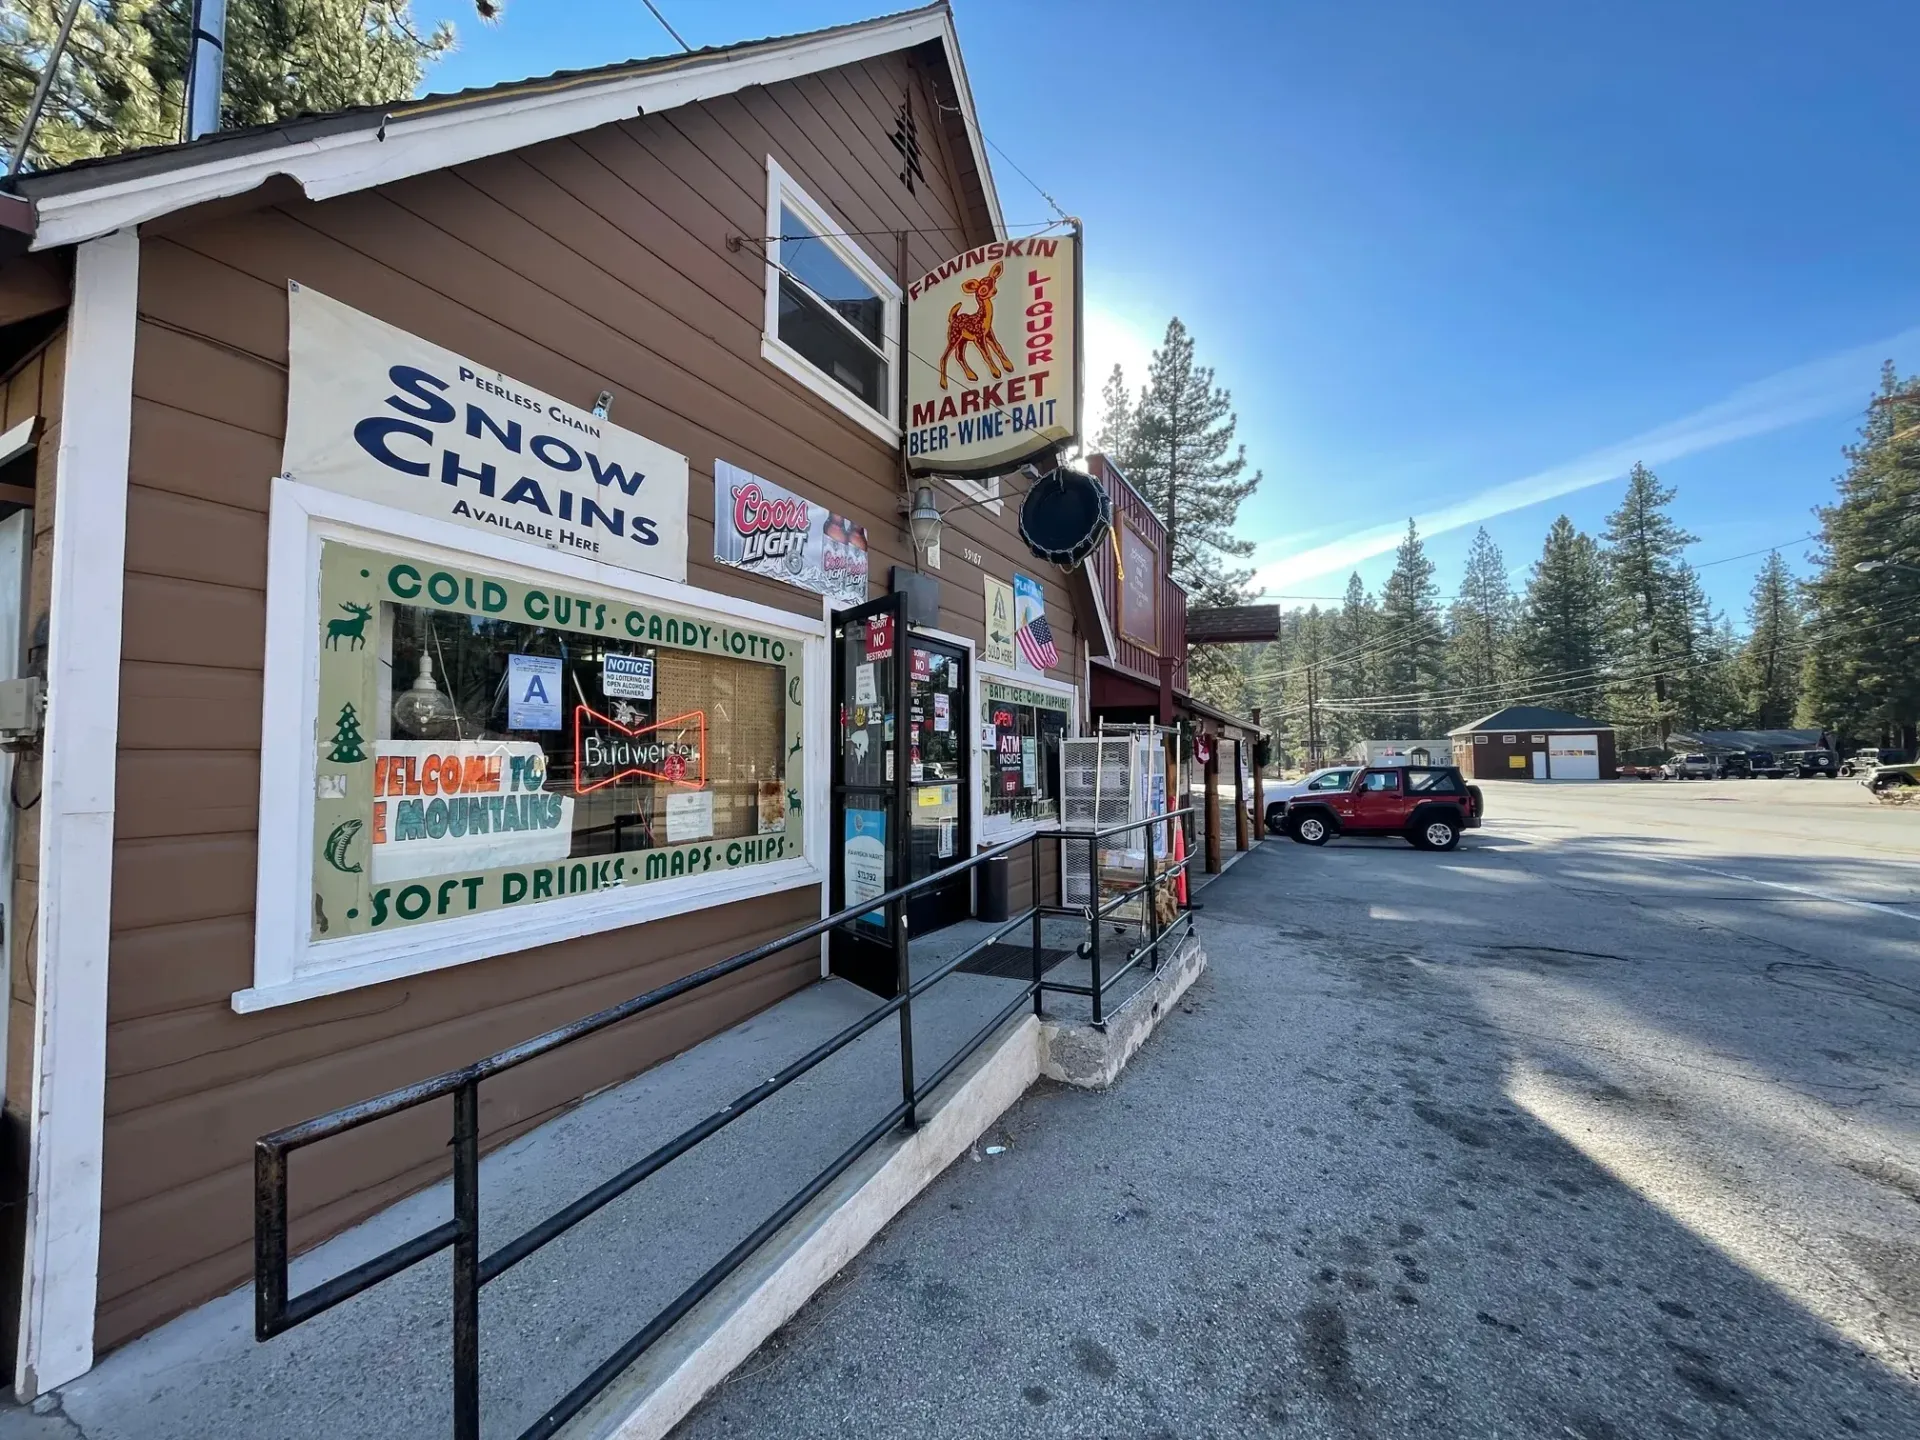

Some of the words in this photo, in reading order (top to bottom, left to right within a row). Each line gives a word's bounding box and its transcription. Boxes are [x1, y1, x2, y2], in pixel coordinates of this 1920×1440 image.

[909, 239, 1059, 301] FAWNSKIN
[1025, 270, 1054, 366] LIQUOR
[458, 366, 542, 414] PEERLESS
[549, 406, 600, 438] CHAIN
[912, 370, 1050, 428] MARKET
[384, 365, 645, 496] SNOW
[353, 416, 660, 546] CHAINS
[732, 483, 810, 535] Coors
[452, 500, 552, 541] AVAILABLE
[559, 529, 600, 553] HERE
[742, 531, 808, 563] LIGHT
[387, 564, 508, 613] COLD
[524, 590, 607, 631] CUTS
[625, 610, 712, 649] CANDY
[722, 629, 785, 662] LOTTO
[870, 619, 888, 631] SORRY
[866, 648, 893, 661] RESTROOM
[873, 632, 885, 648] NO
[606, 673, 615, 681] NO
[615, 675, 642, 683] LOITERING
[607, 658, 651, 675] NOTICE
[915, 659, 925, 671] NO
[523, 674, 549, 704] A
[606, 680, 621, 688] OPEN
[612, 688, 645, 697] CONTAINERS
[989, 684, 1006, 700] BAIT
[1011, 688, 1022, 702] ICE
[993, 711, 1014, 728] OPEN
[999, 753, 1021, 765] INSIDE
[1000, 735, 1020, 753] ATM
[510, 755, 546, 792] TO
[1006, 781, 1016, 791] EBT
[395, 792, 563, 841] MOUNTAINS
[371, 876, 484, 927] SOFT
[502, 857, 625, 905] DRINKS
[646, 846, 713, 880] MAPS
[726, 836, 785, 866] CHIPS
